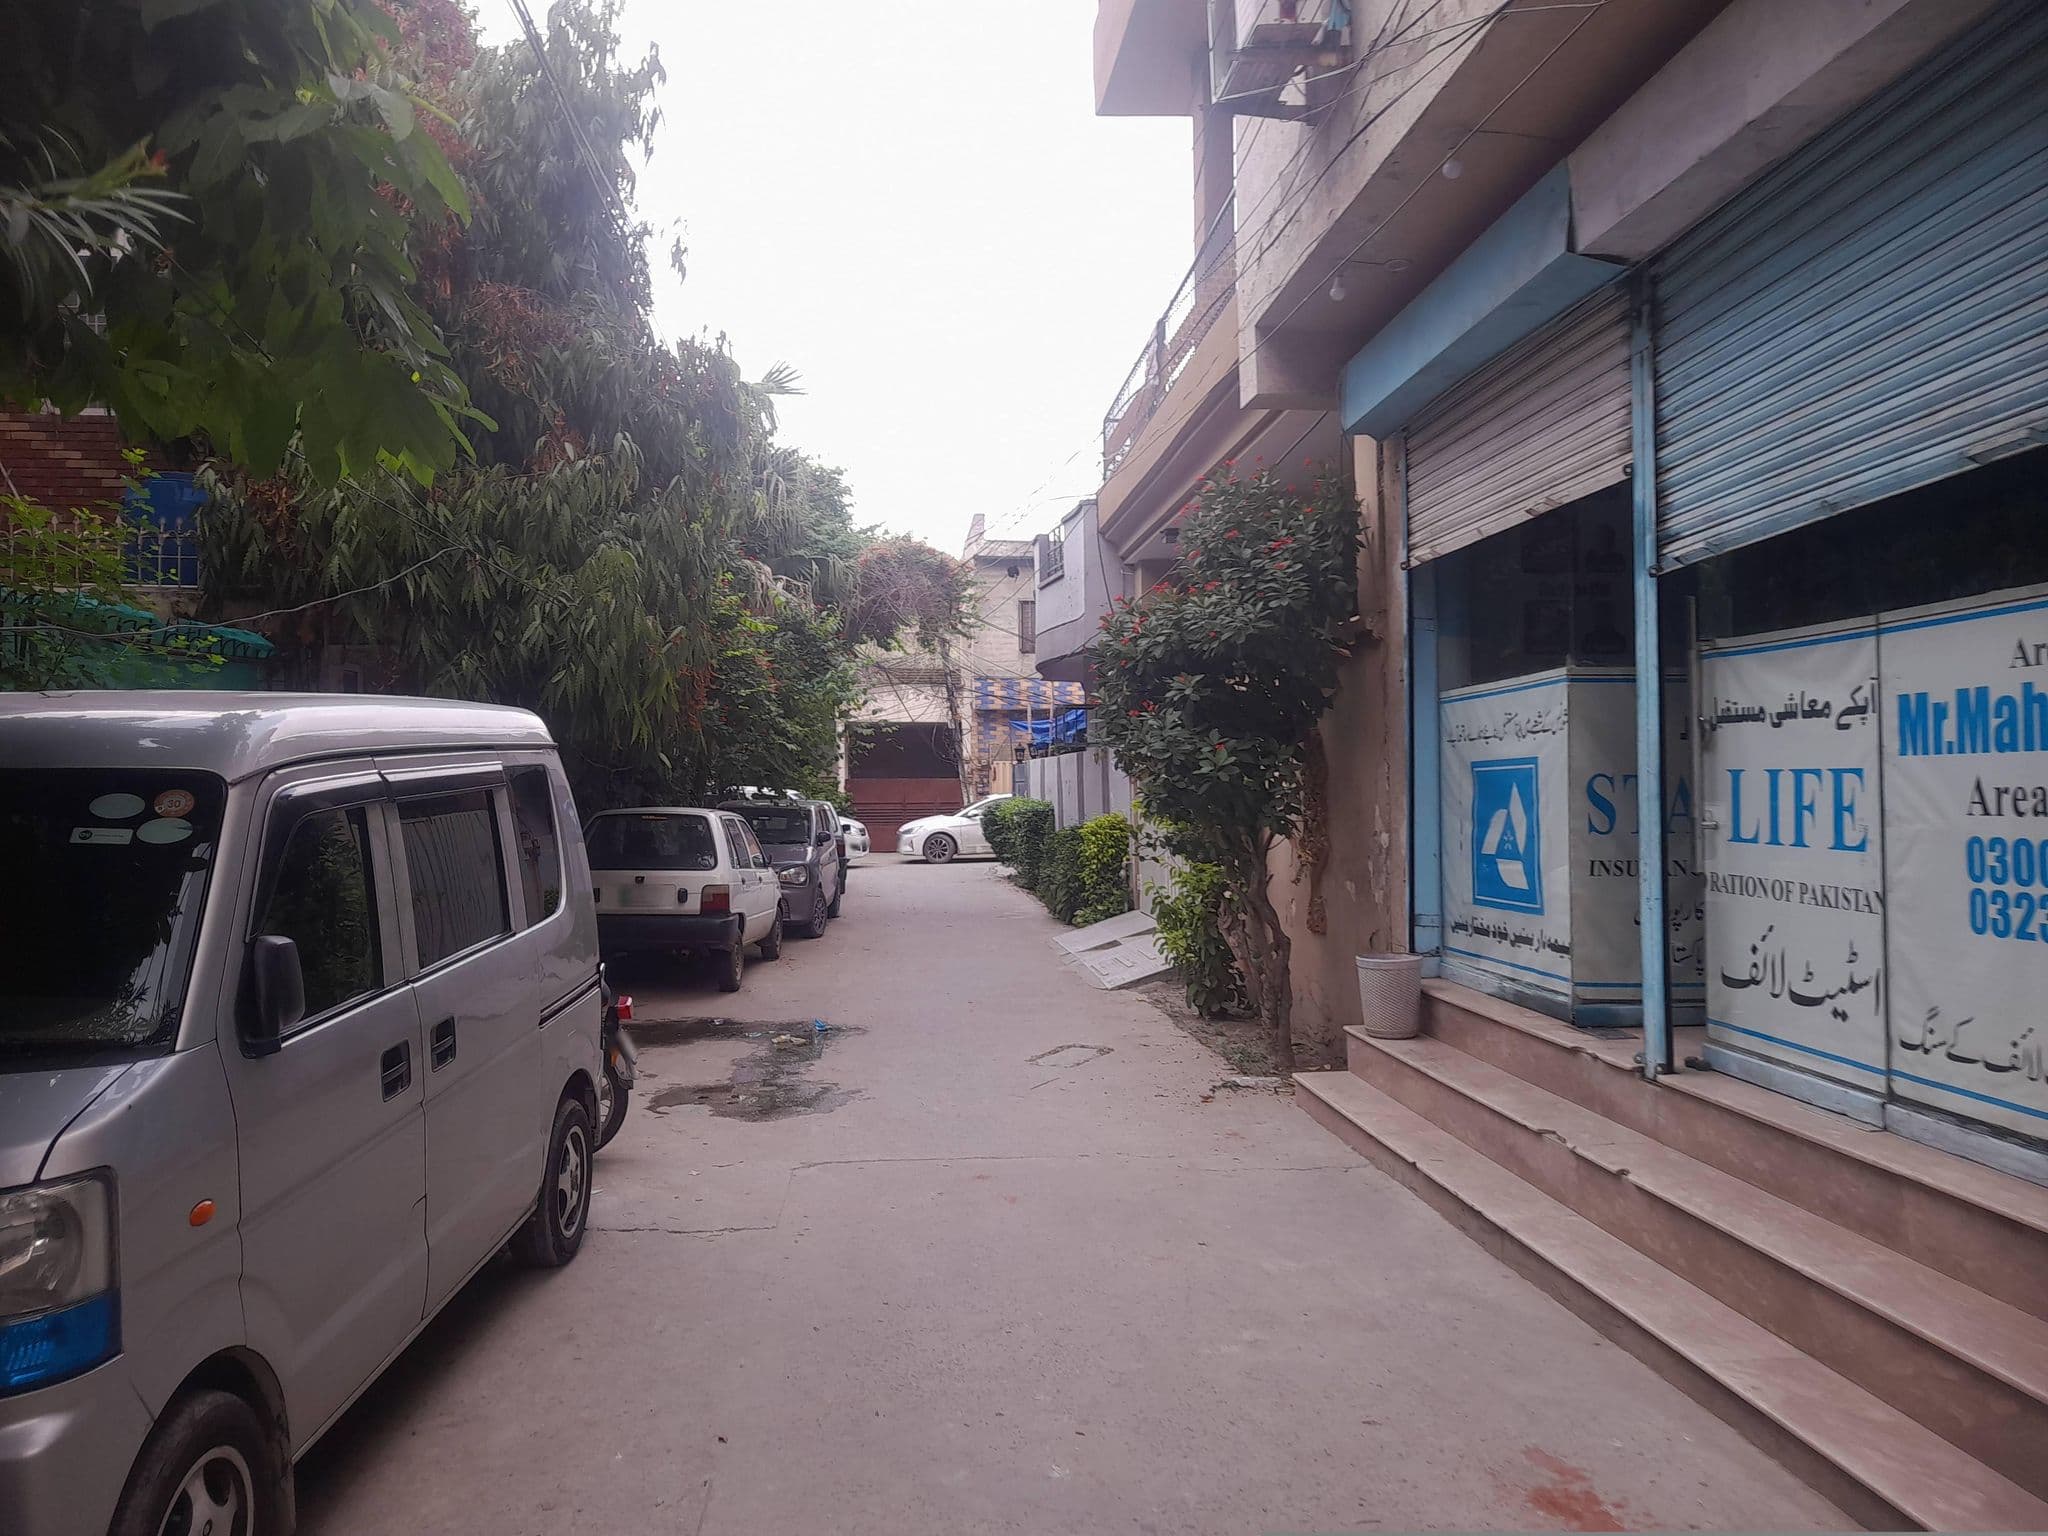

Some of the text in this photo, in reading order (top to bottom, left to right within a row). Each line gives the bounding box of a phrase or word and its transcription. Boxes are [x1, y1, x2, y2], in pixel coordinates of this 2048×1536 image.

[1769, 690, 1832, 728] معاشی
[1727, 768, 1867, 851] LIFE
[1966, 774, 2048, 818] Area
[1771, 878, 1801, 903] OF
